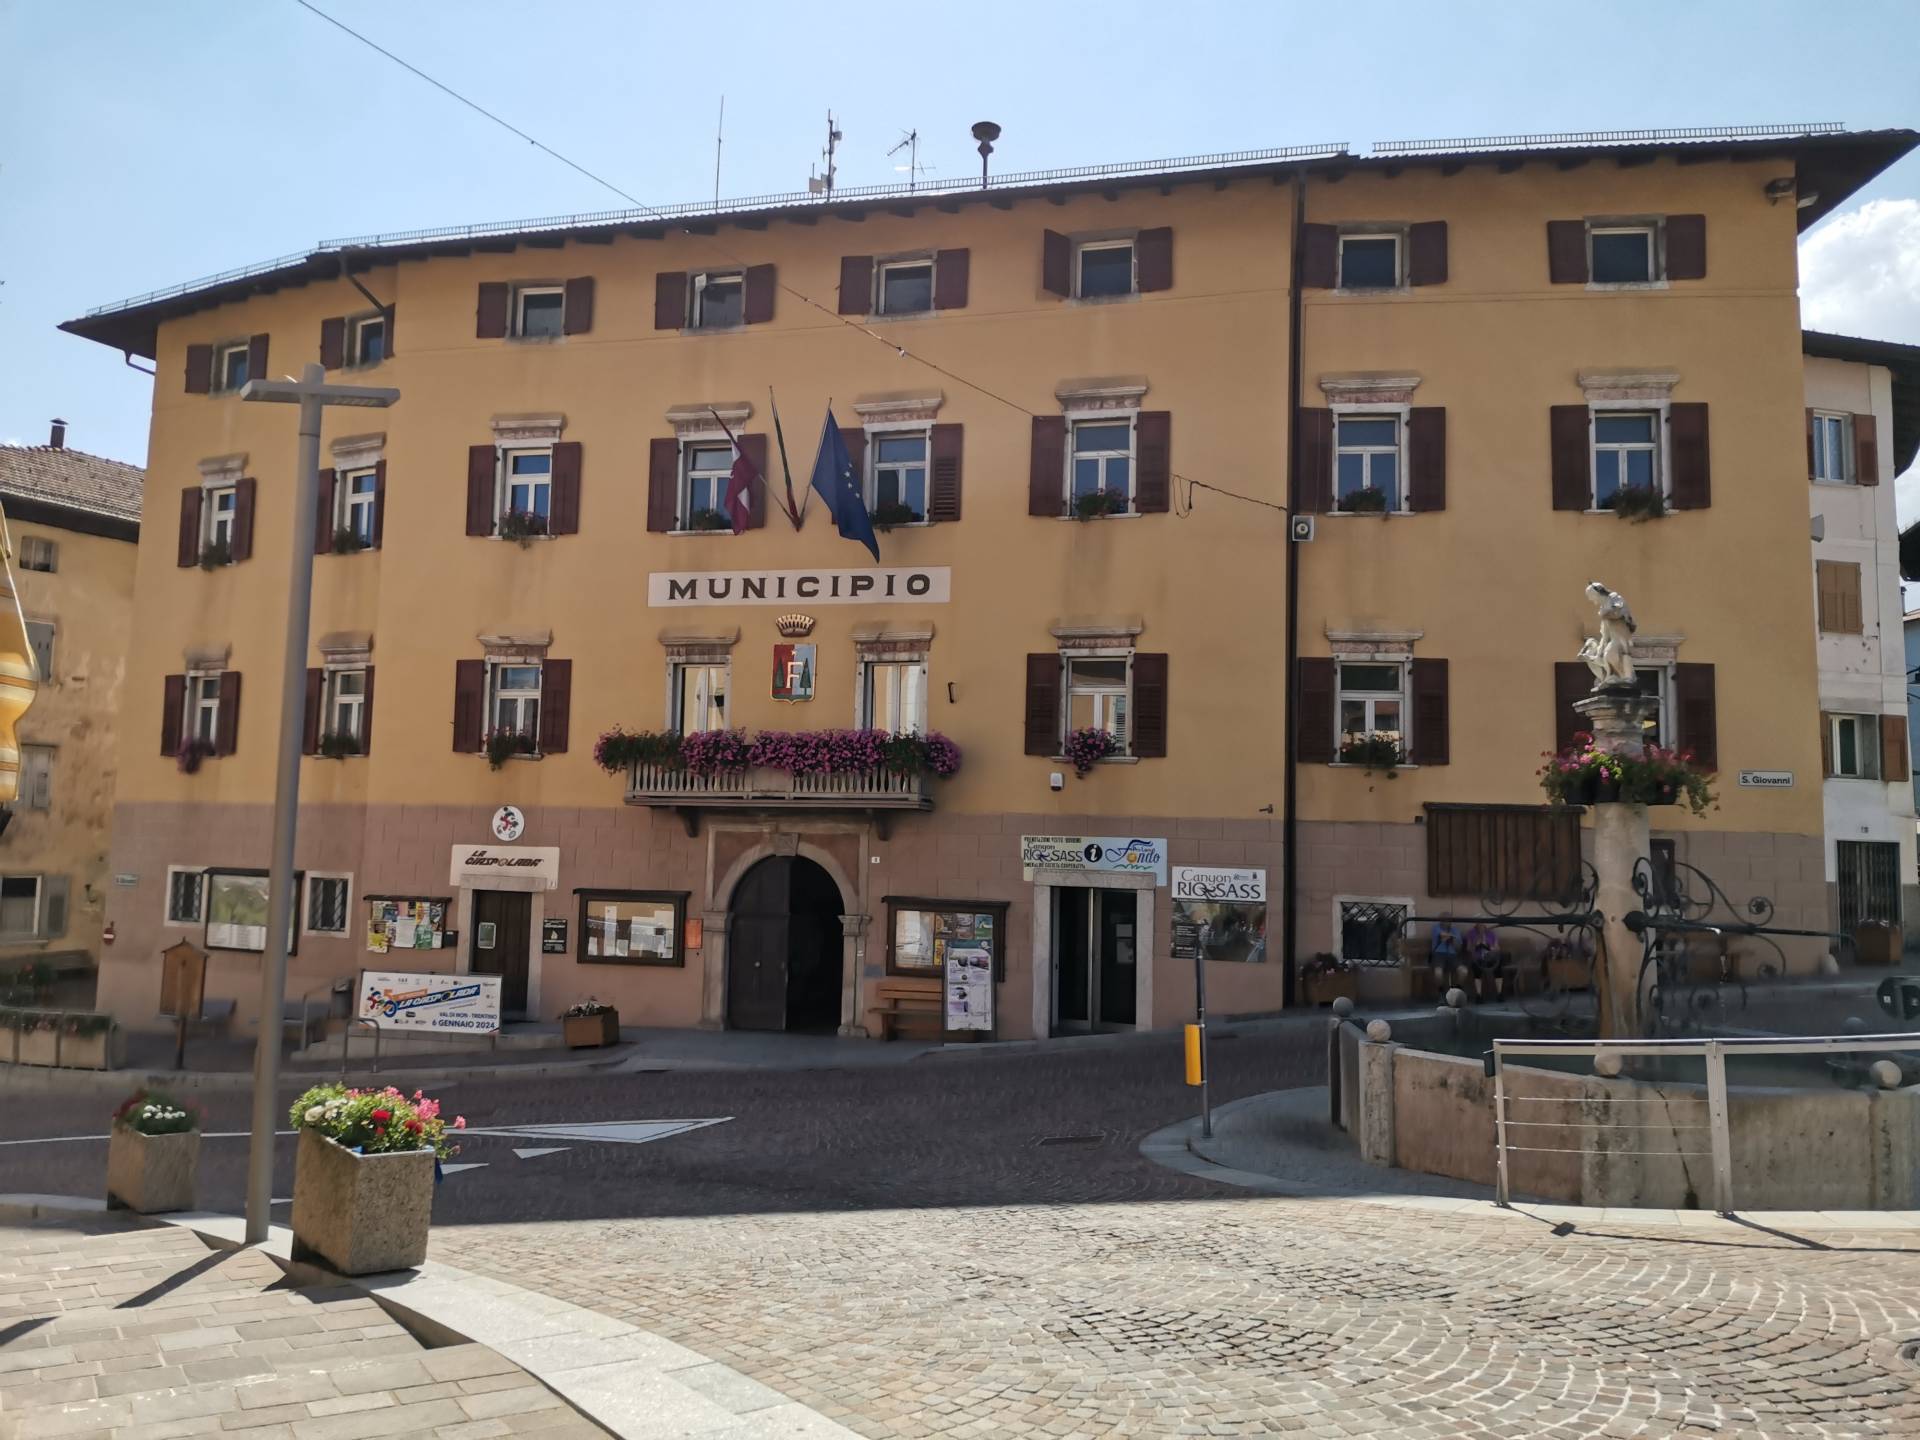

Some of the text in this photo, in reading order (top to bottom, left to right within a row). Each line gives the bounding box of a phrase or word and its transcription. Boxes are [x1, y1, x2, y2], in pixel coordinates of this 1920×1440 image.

[668, 573, 931, 601] MUNICIPIO
[1742, 775, 1790, 785] S. Giovanni
[1027, 841, 1056, 851] Canyon
[465, 857, 542, 867] CIASPOLADA
[1181, 869, 1232, 884] Canyon
[399, 1000, 413, 1009] LA
[432, 1019, 438, 1027] 6
[439, 1019, 474, 1028] GENNAIO
[475, 1020, 496, 1029] 2024
